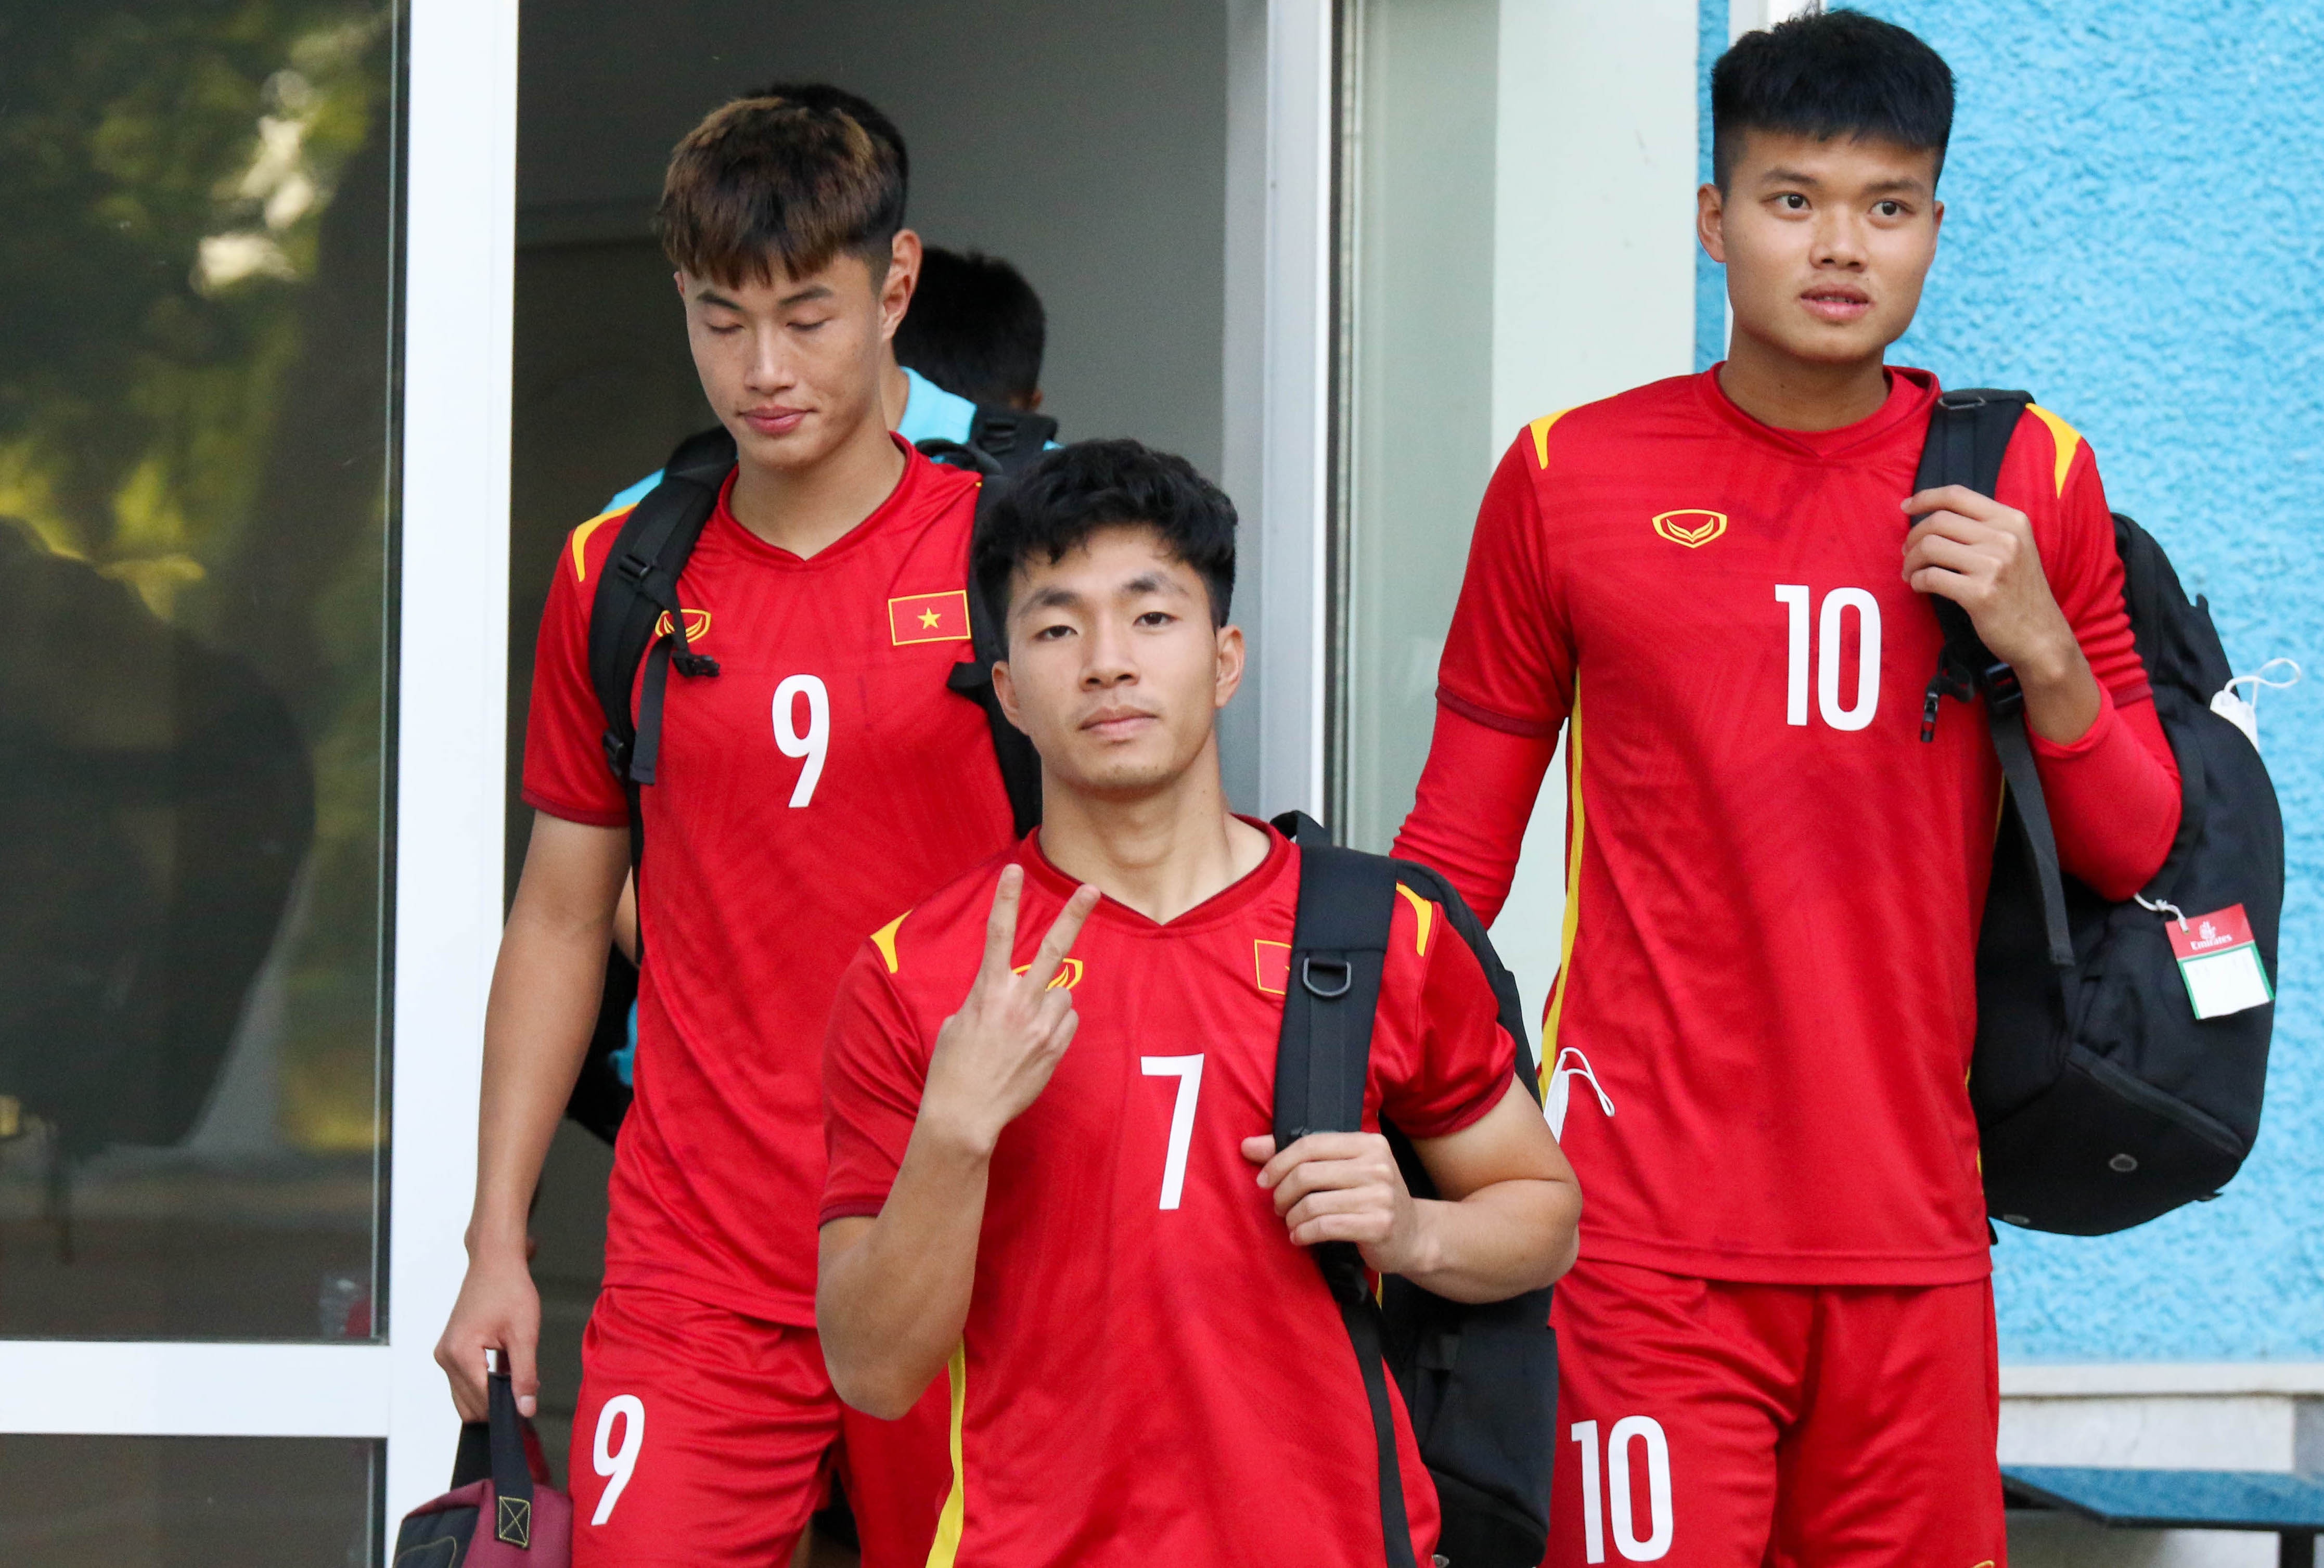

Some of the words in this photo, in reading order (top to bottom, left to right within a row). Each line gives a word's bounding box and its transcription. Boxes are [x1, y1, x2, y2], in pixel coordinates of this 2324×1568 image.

[1775, 584, 1882, 731] 10
[772, 674, 830, 808] 9
[2190, 934, 2233, 950] Emirates
[1140, 1053, 1205, 1210] 7
[591, 1394, 645, 1526] 9
[1571, 1415, 1674, 1564] 10
